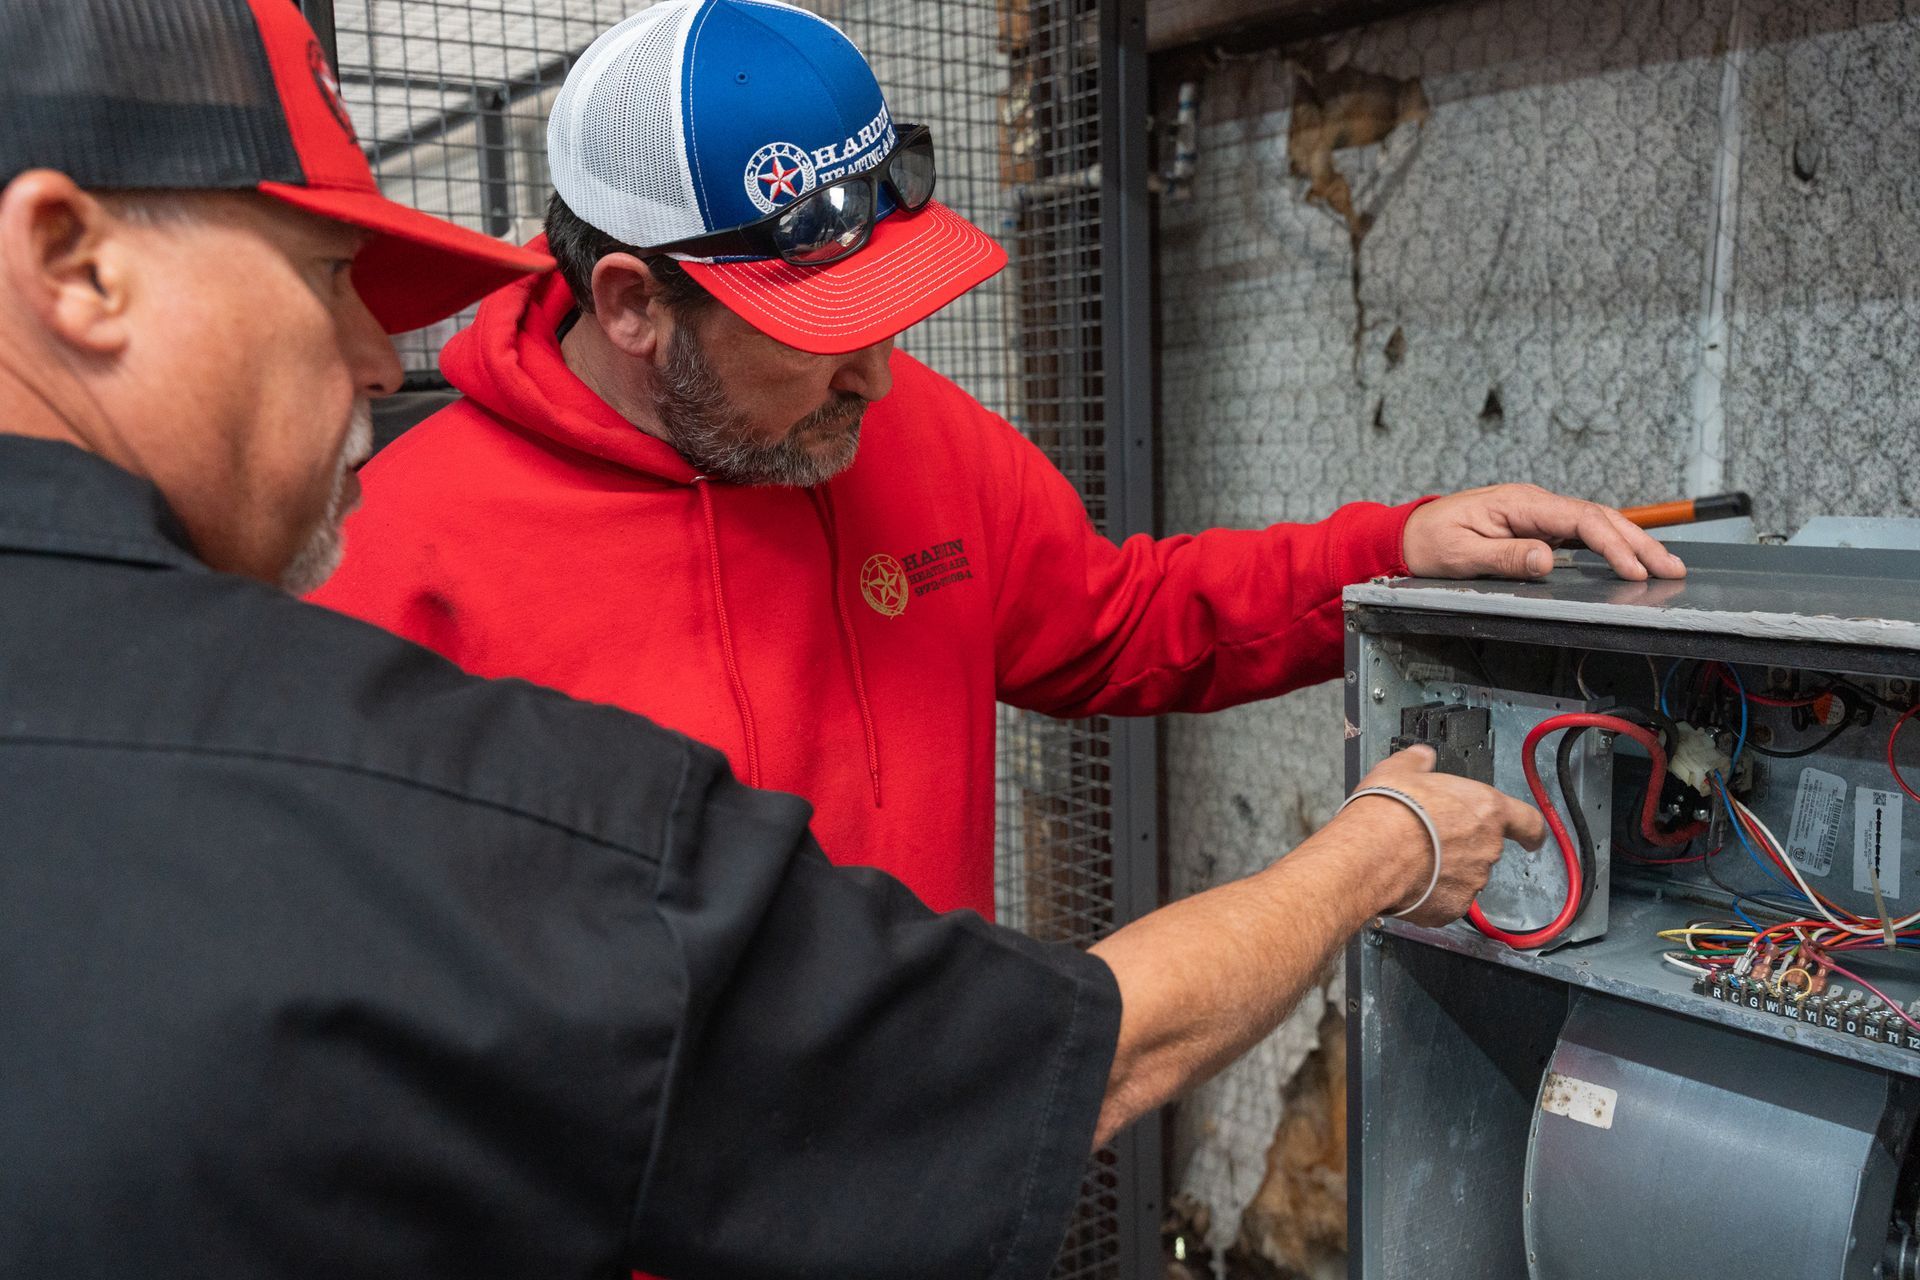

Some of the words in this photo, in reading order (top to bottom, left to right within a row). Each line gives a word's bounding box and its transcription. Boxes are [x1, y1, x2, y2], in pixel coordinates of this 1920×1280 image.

[748, 145, 802, 169] TEXAS
[1713, 987, 1721, 998] R
[1731, 993, 1739, 1003] C
[1749, 997, 1758, 1007] G
[1766, 1000, 1779, 1013] W1
[1784, 1004, 1798, 1017] W2
[1805, 1010, 1817, 1023] Y1
[1824, 1014, 1837, 1027] Y2
[1846, 1021, 1856, 1032] O
[1864, 1025, 1878, 1038] DH
[1887, 1031, 1899, 1044] T1
[1907, 1036, 1920, 1049] T2
